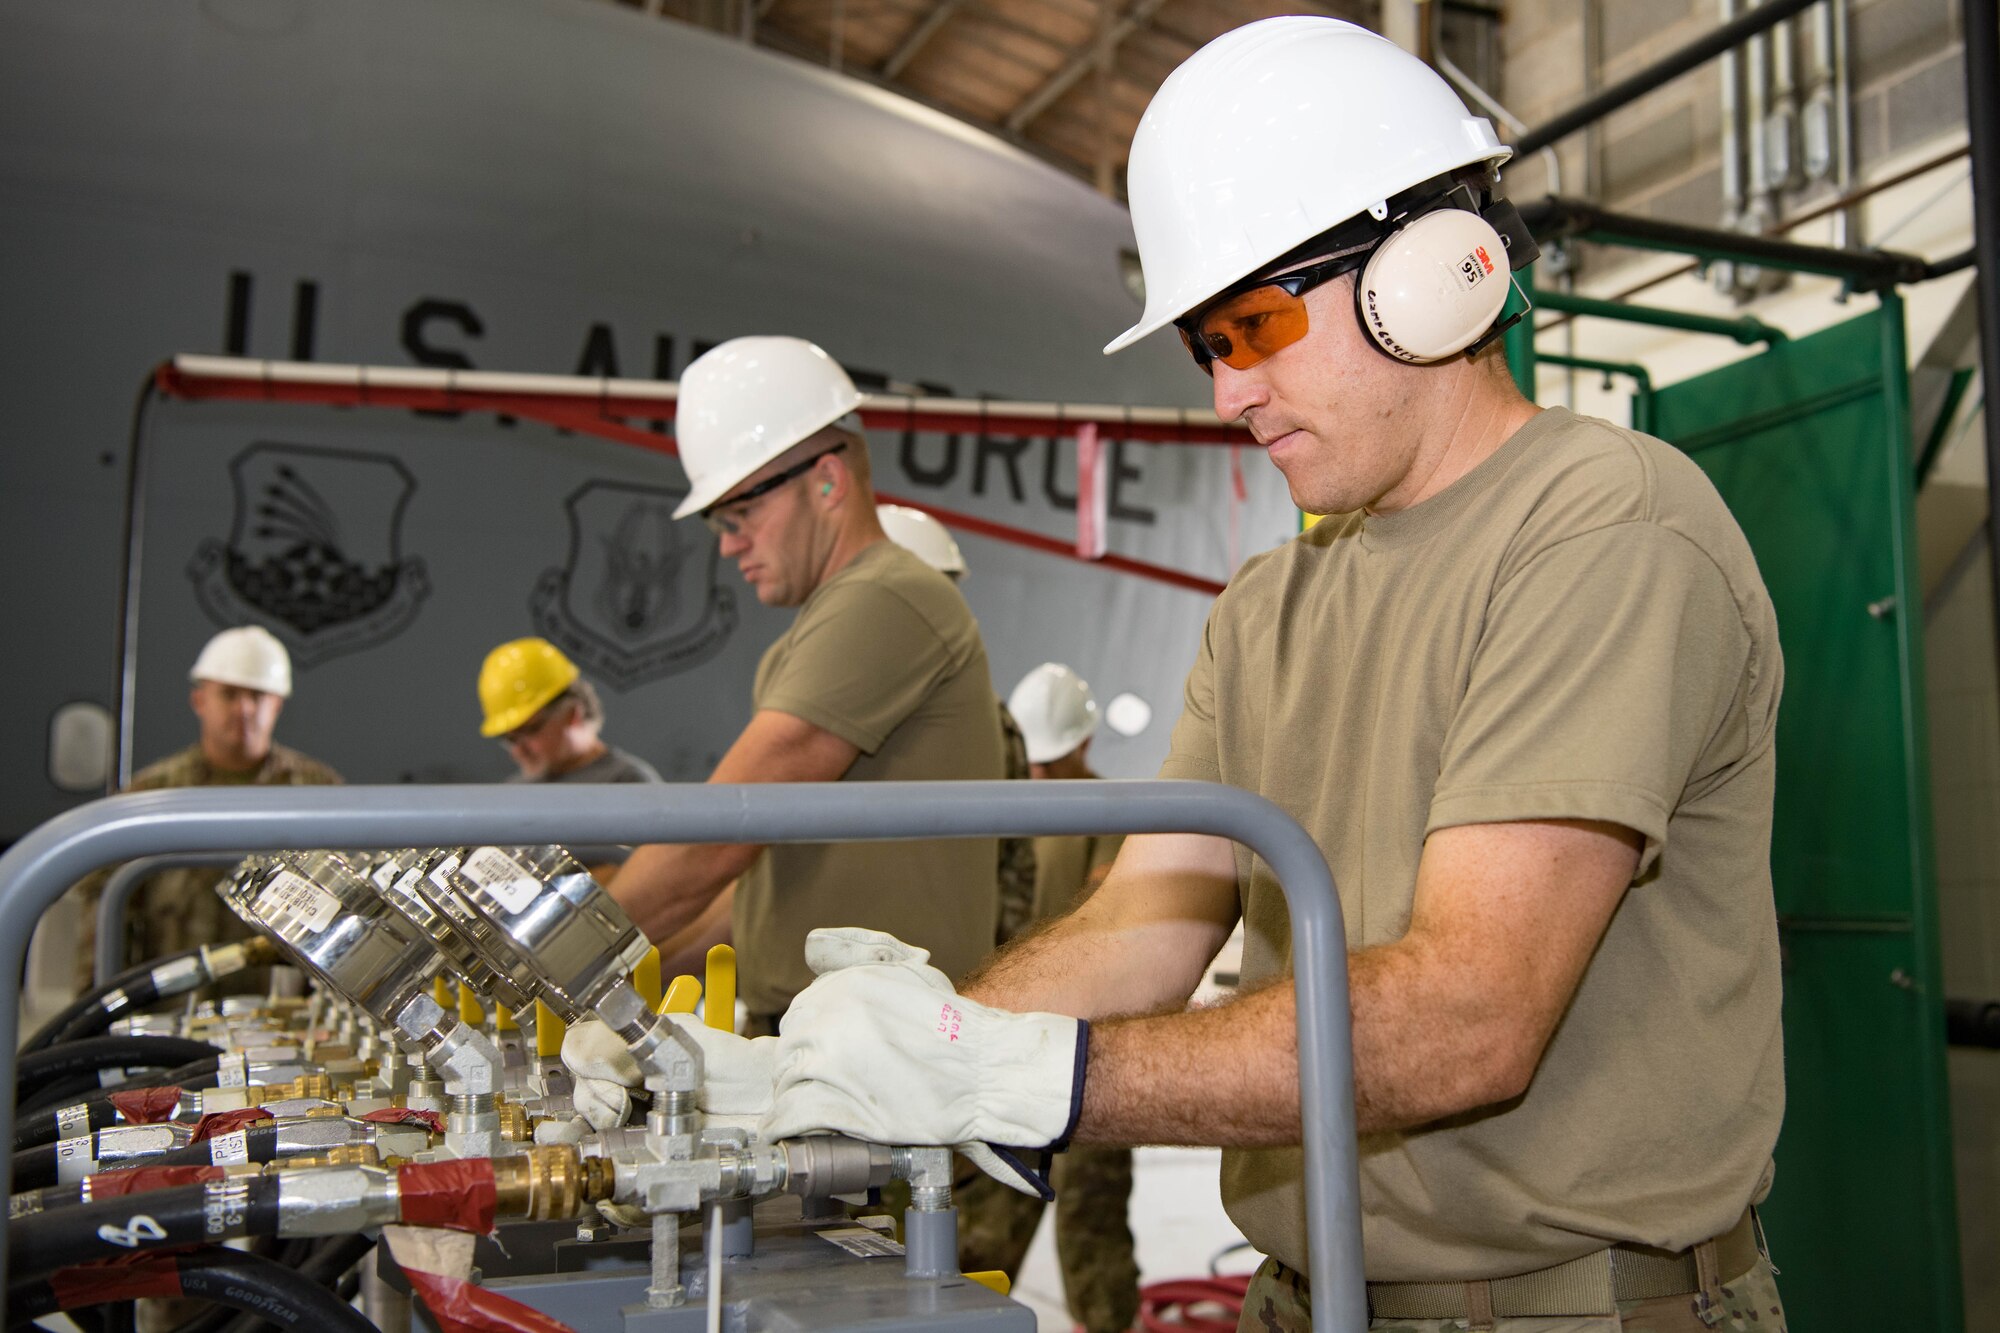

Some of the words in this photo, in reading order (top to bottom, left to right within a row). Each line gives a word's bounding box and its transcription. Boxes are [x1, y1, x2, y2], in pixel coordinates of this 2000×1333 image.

[1461, 261, 1478, 284] 95
[1475, 245, 1495, 276] 3M
[225, 1285, 299, 1323] GOODYEAR
